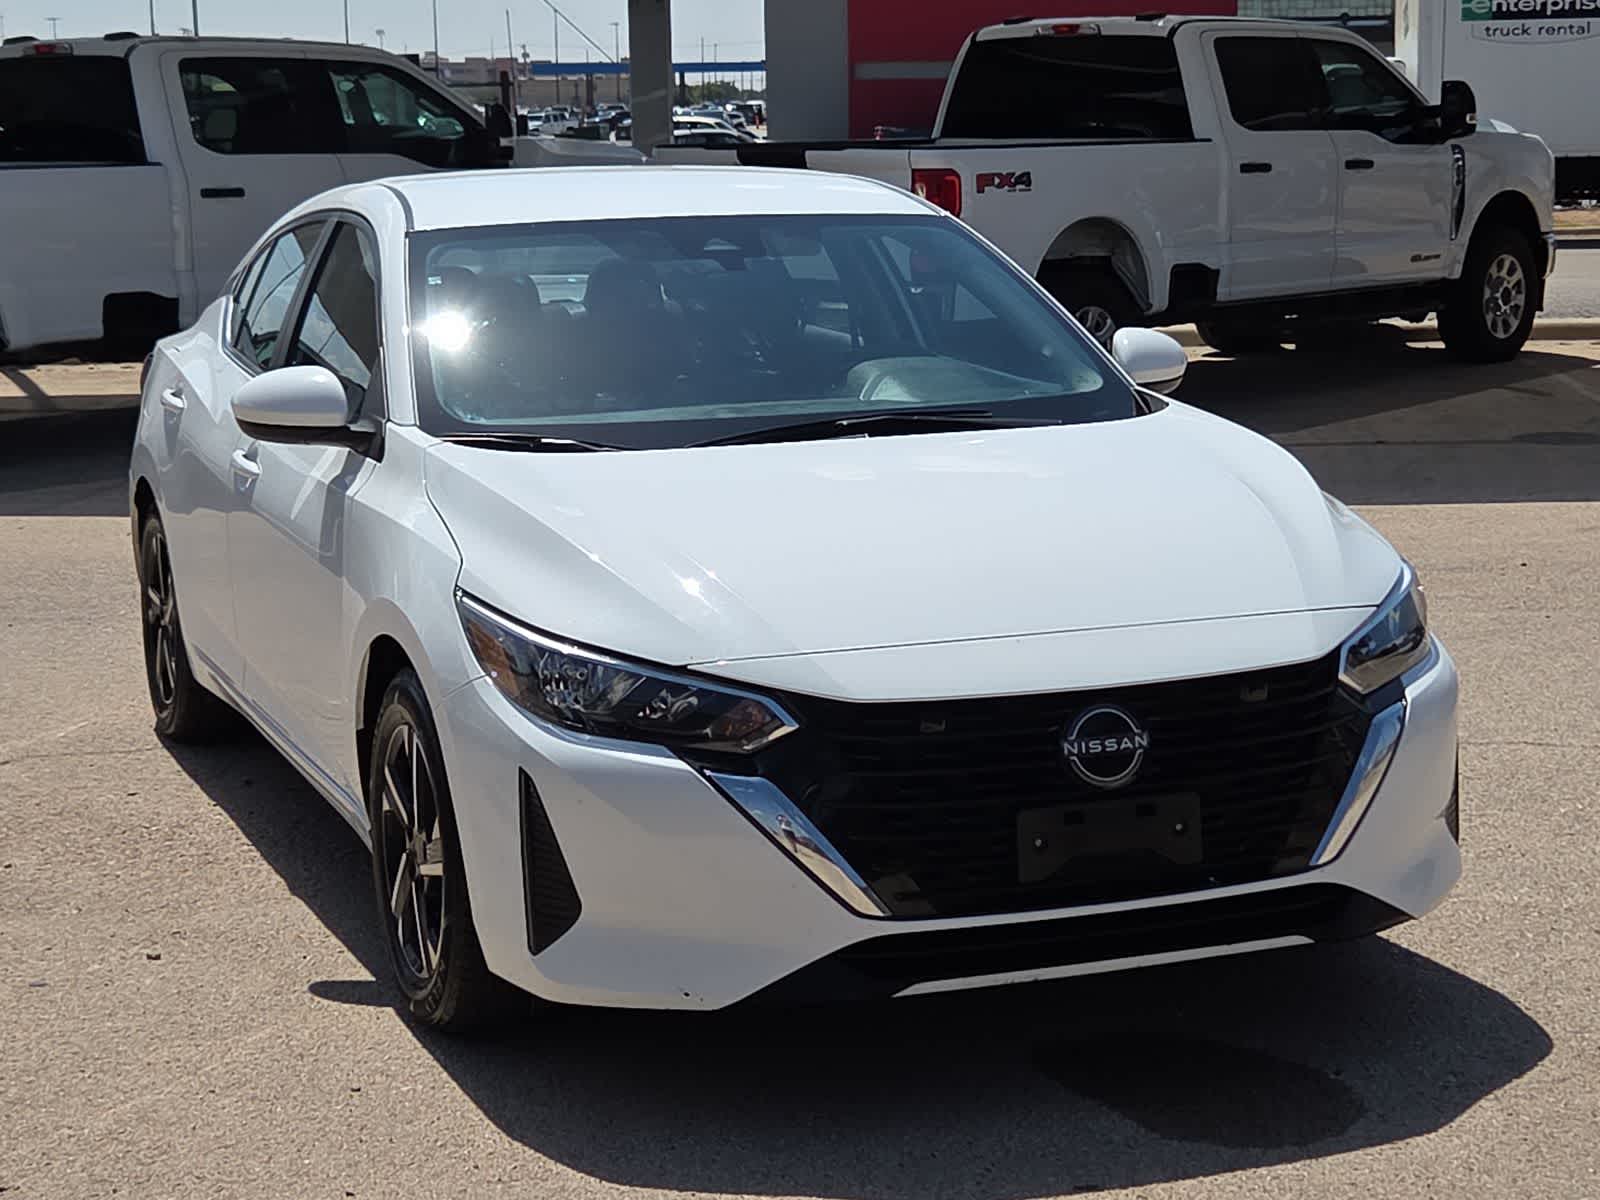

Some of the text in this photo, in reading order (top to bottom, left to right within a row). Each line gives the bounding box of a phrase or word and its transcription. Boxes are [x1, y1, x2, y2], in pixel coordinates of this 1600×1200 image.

[1484, 21, 1591, 37] truck rental
[976, 171, 1032, 193] FX4
[1063, 734, 1148, 756] NISSAN
